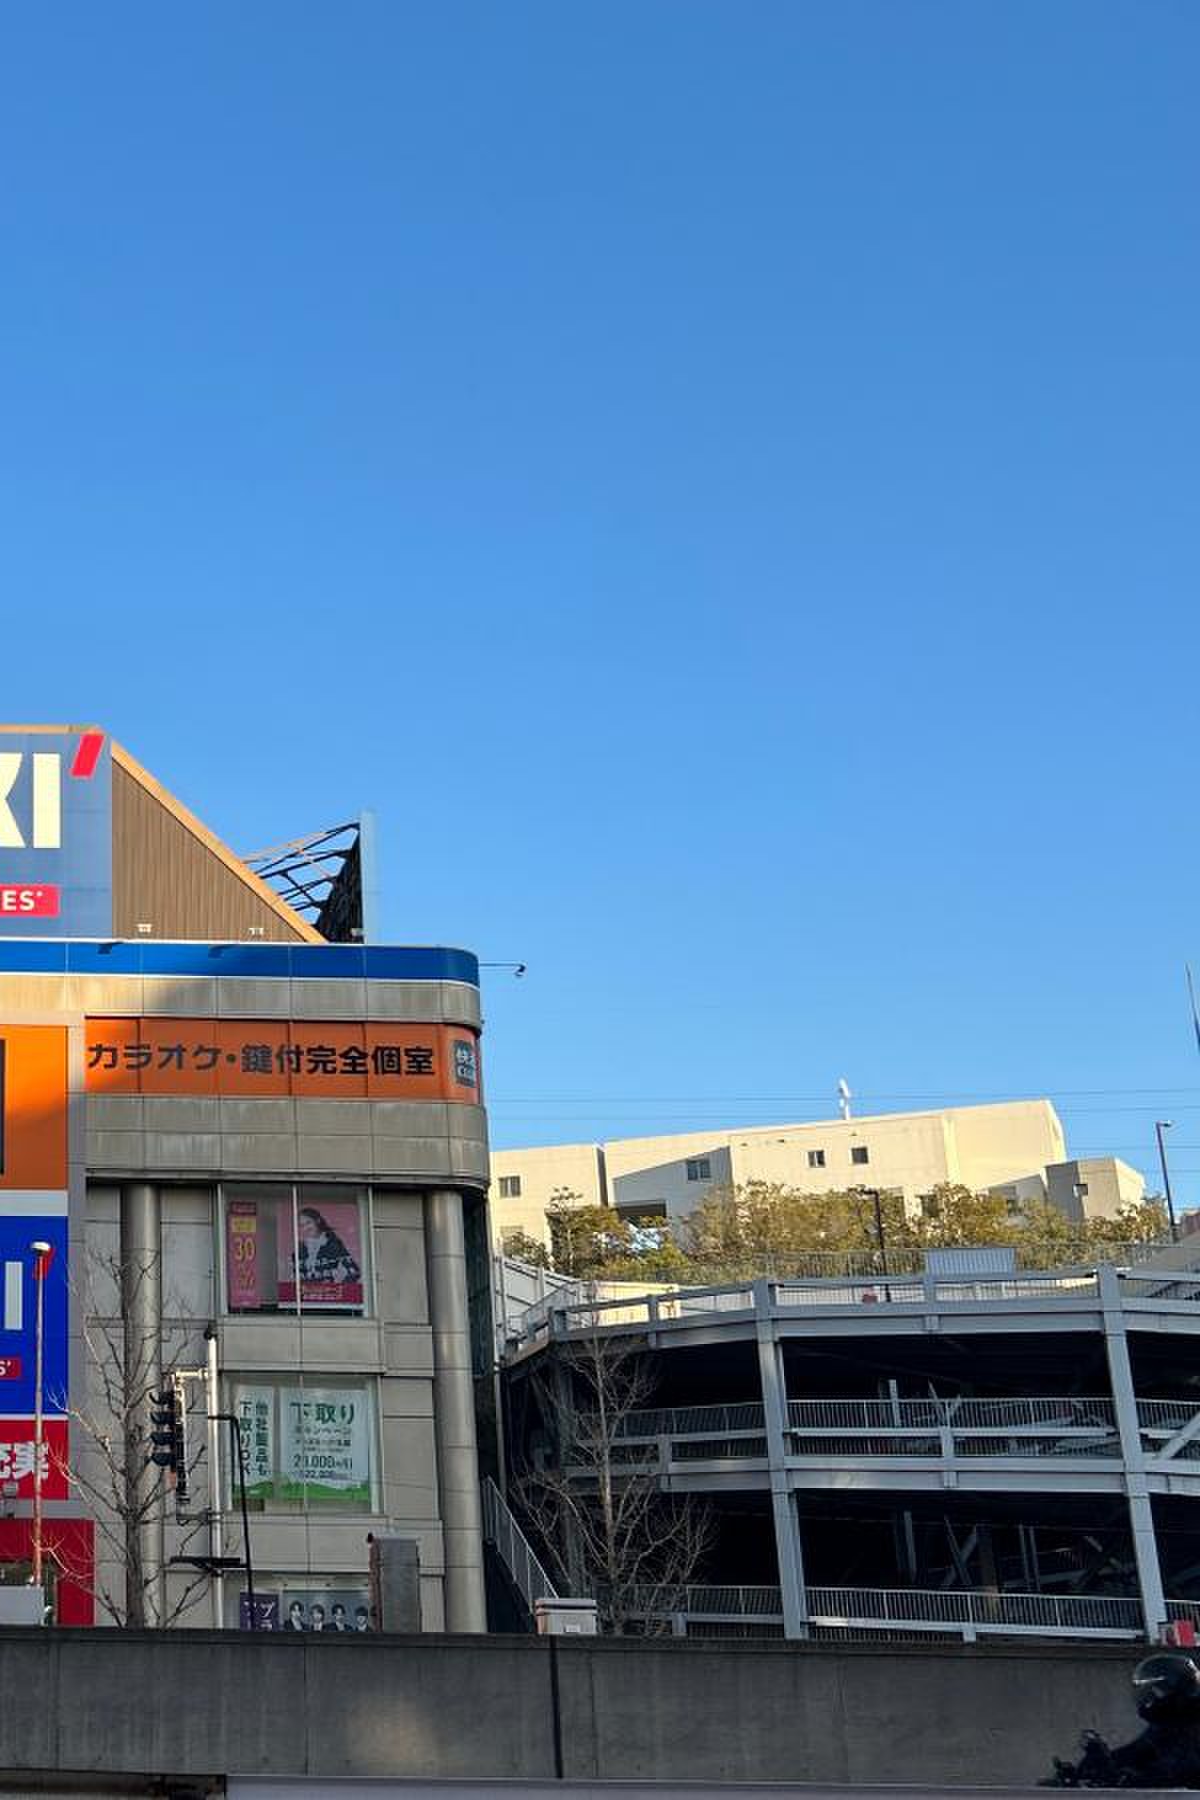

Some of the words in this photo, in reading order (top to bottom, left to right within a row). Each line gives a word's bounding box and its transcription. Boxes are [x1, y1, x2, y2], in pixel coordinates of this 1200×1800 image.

[87, 1044, 435, 1076] カラオケ・鍵付完全個室
[289, 1402, 355, 1424] 下取り
